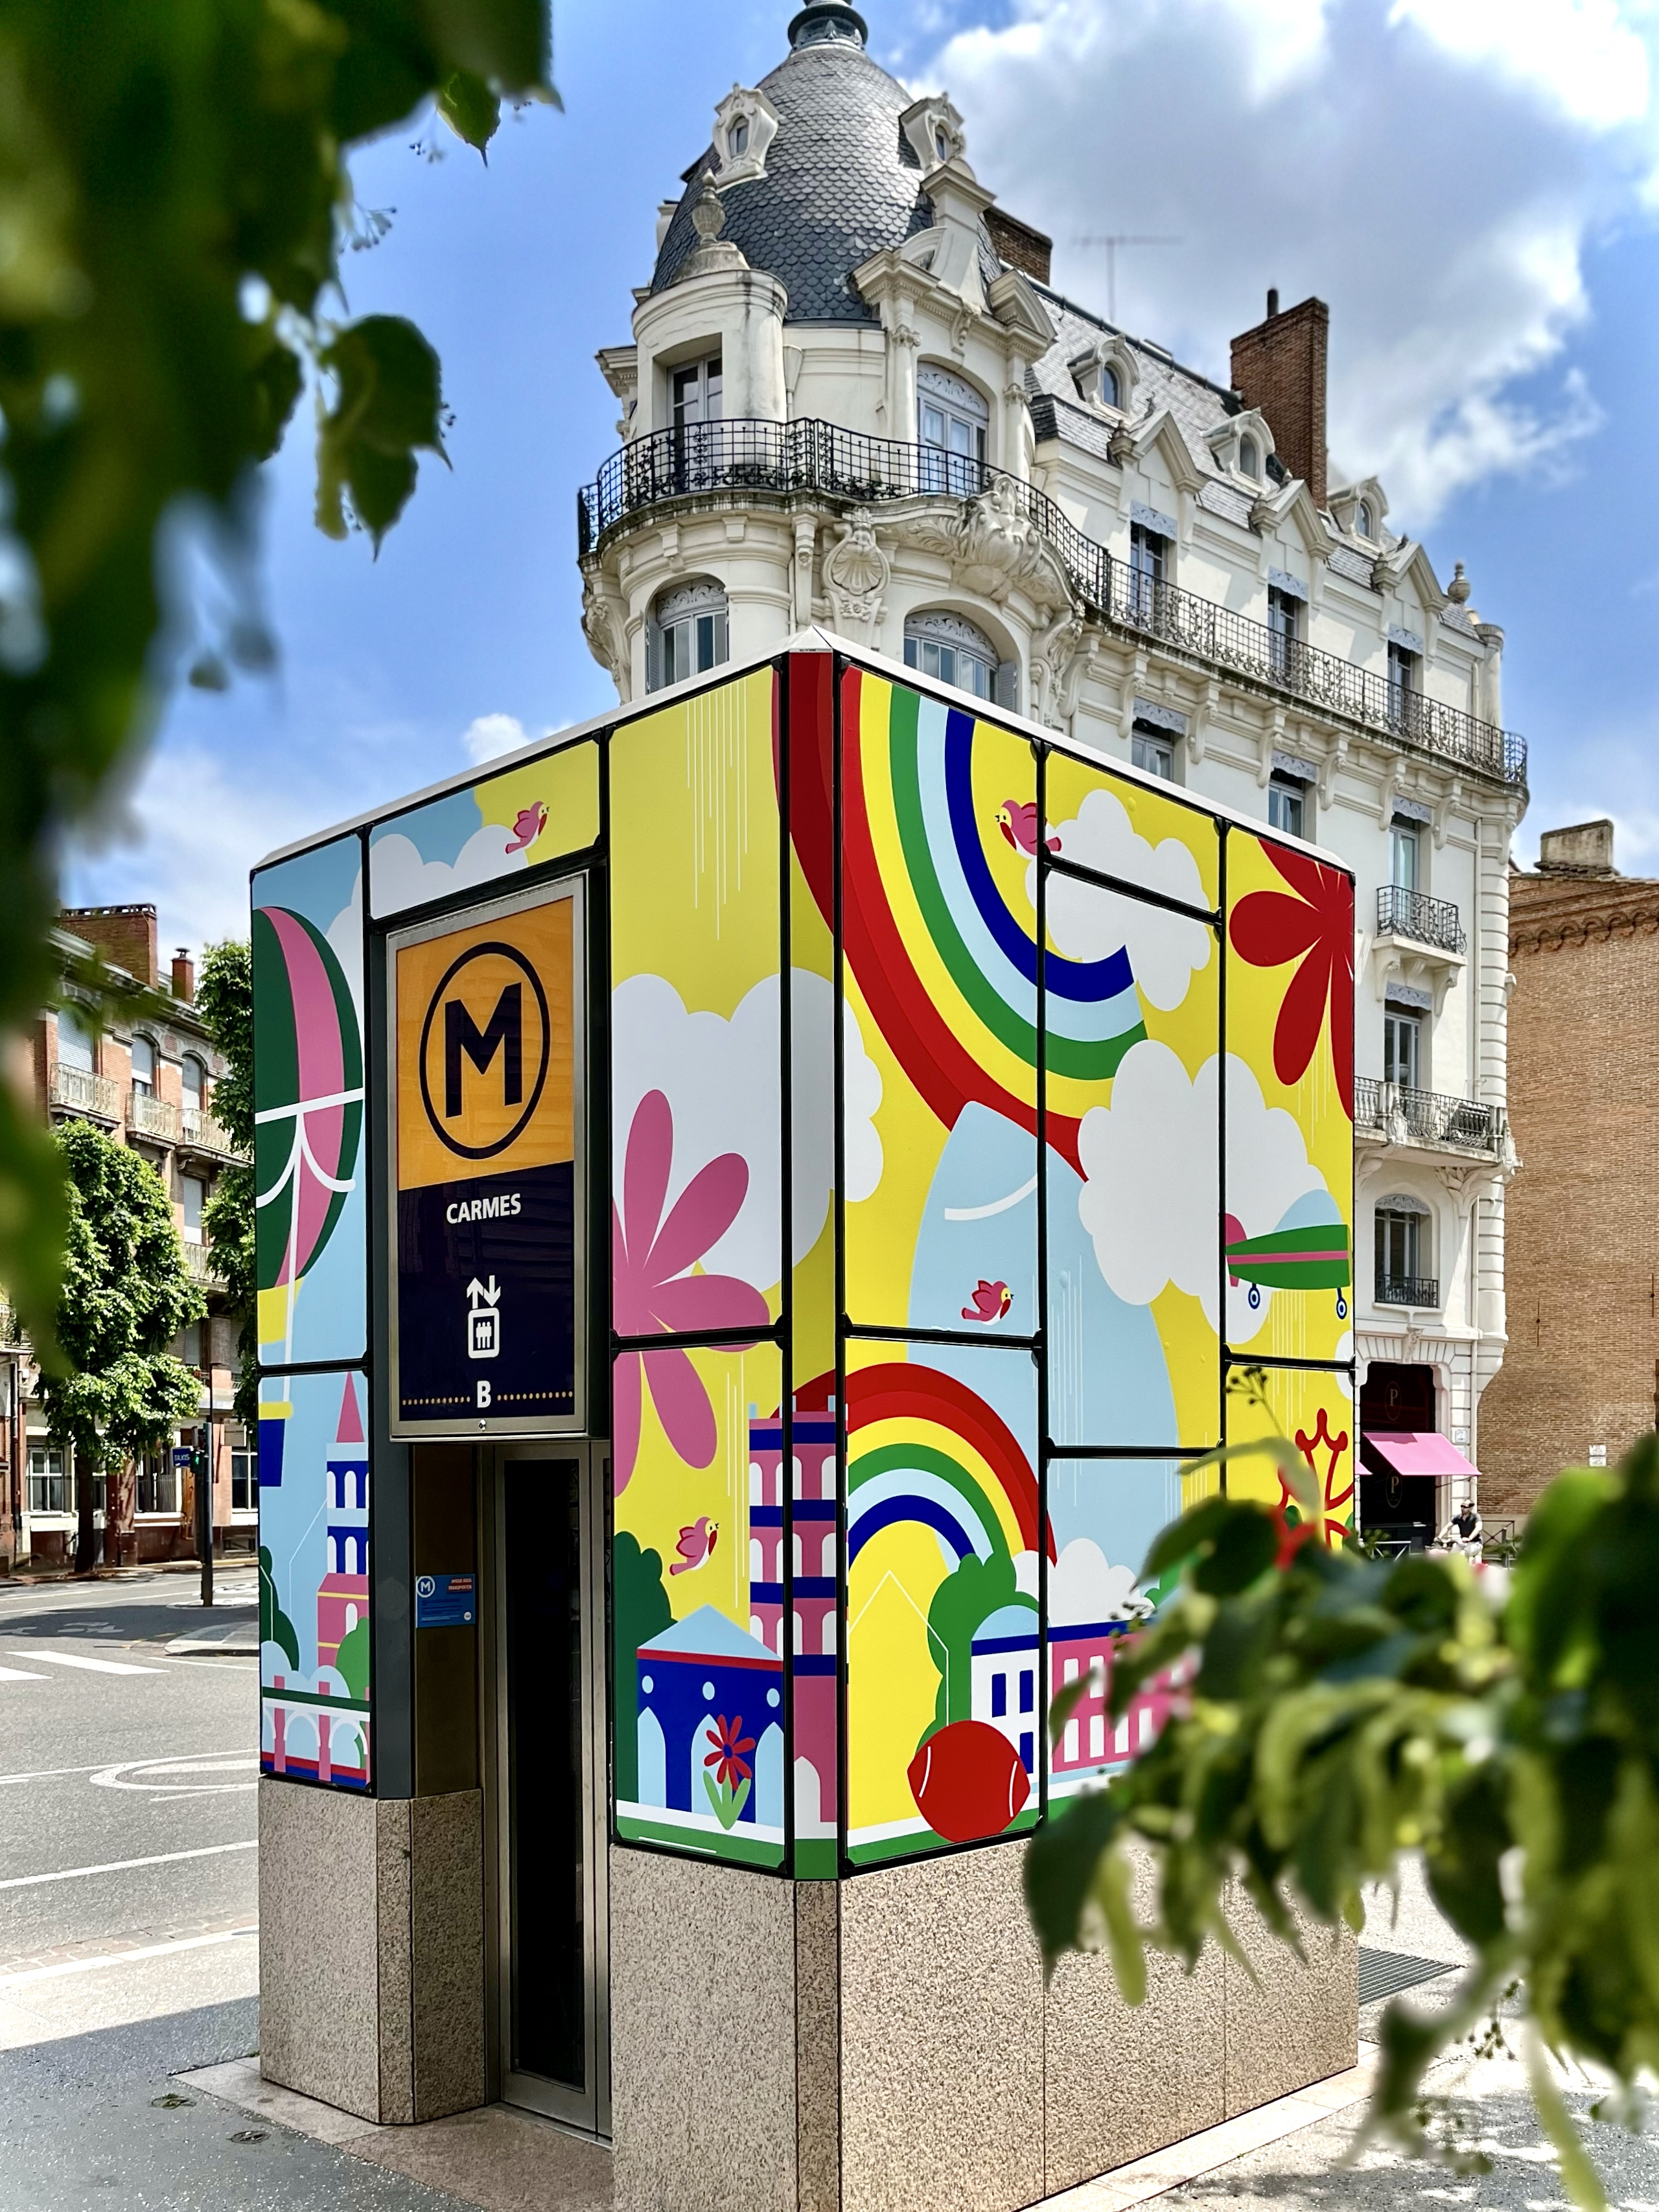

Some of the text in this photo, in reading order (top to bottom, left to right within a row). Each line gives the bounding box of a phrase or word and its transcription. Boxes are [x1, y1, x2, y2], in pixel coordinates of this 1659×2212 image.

[445, 982, 522, 1118] M
[446, 1193, 522, 1225] CARMES
[477, 1380, 491, 1409] B
[1389, 1388, 1398, 1406] P
[1391, 1476, 1399, 1493] P
[421, 1581, 430, 1592] M
